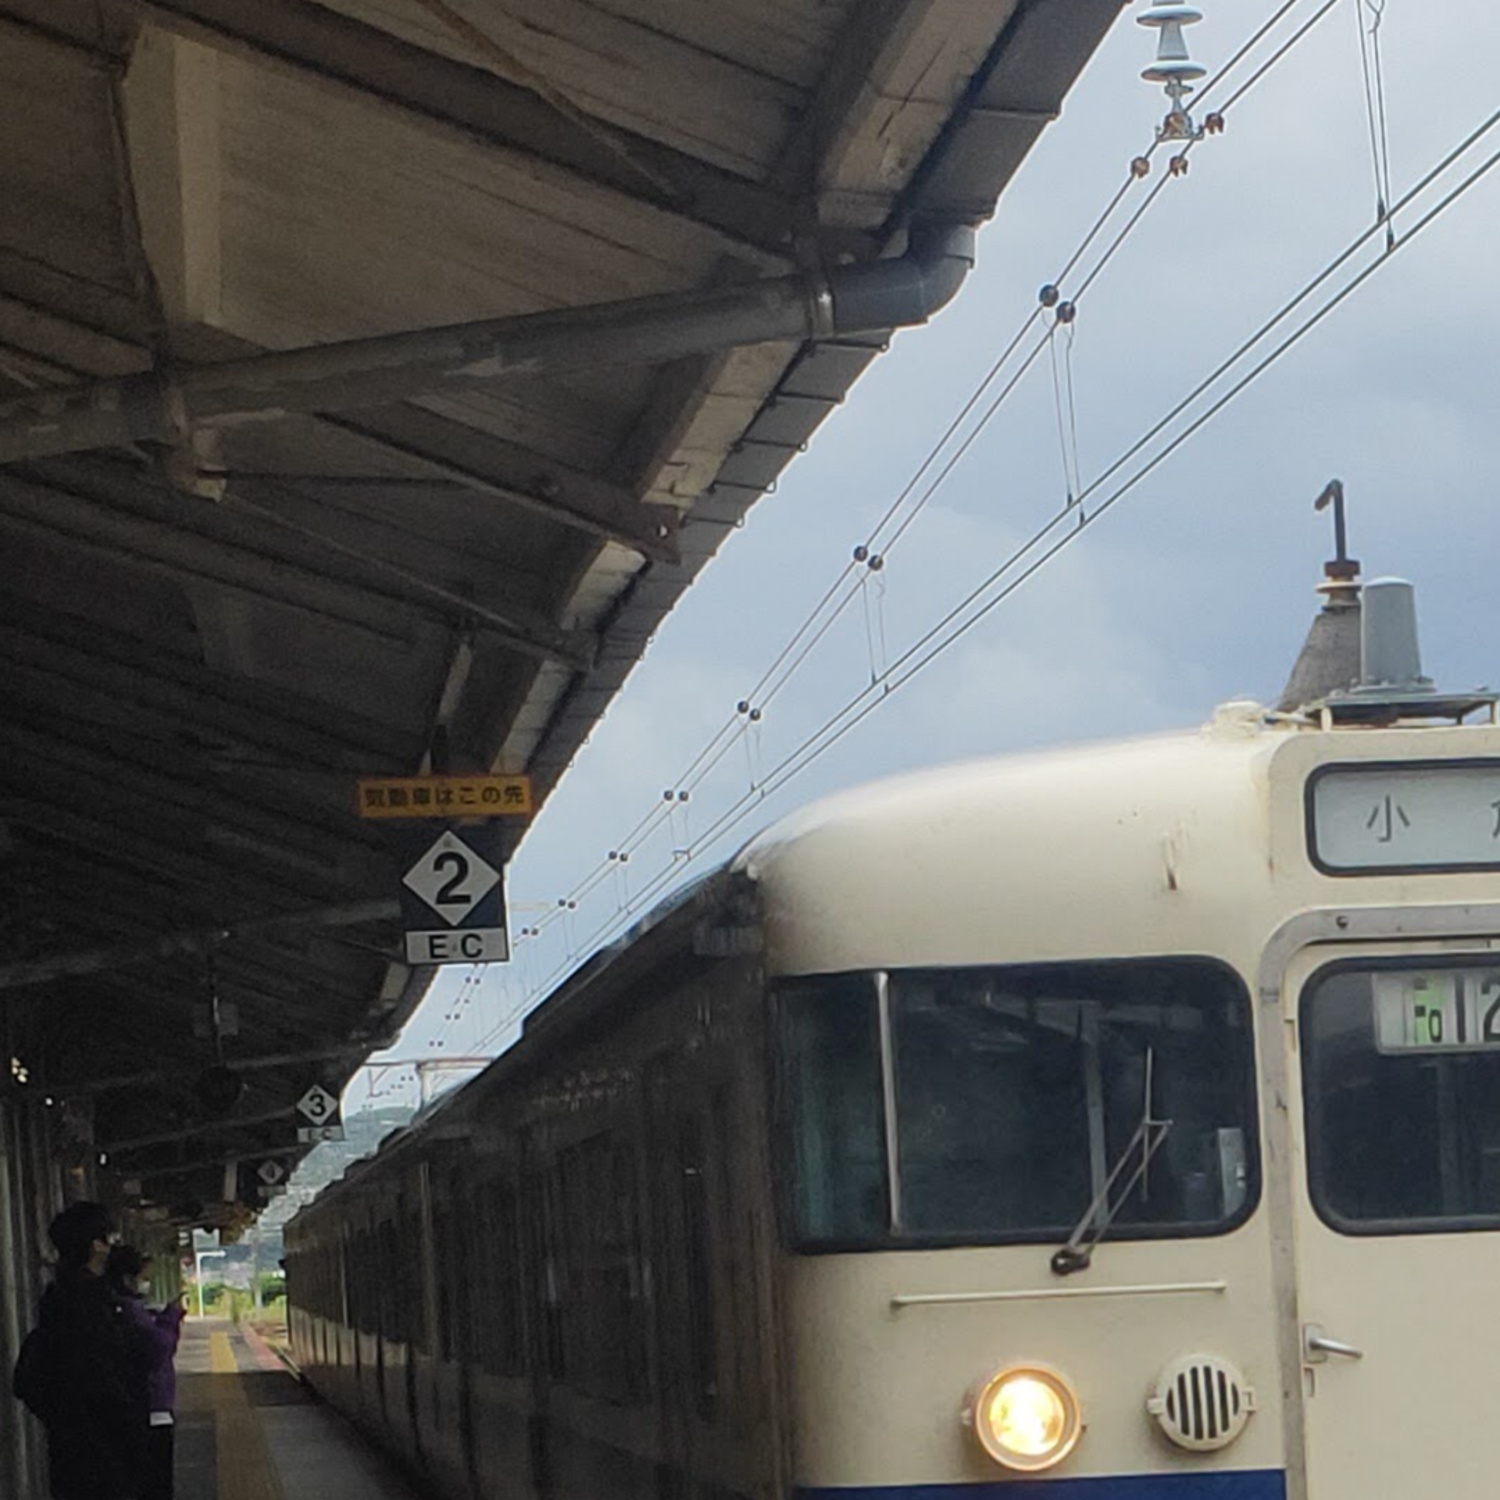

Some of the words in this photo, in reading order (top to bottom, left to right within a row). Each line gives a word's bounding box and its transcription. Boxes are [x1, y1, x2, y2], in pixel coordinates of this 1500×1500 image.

[432, 851, 472, 905] 2
[428, 933, 483, 960] EC
[309, 1094, 326, 1117] 3
